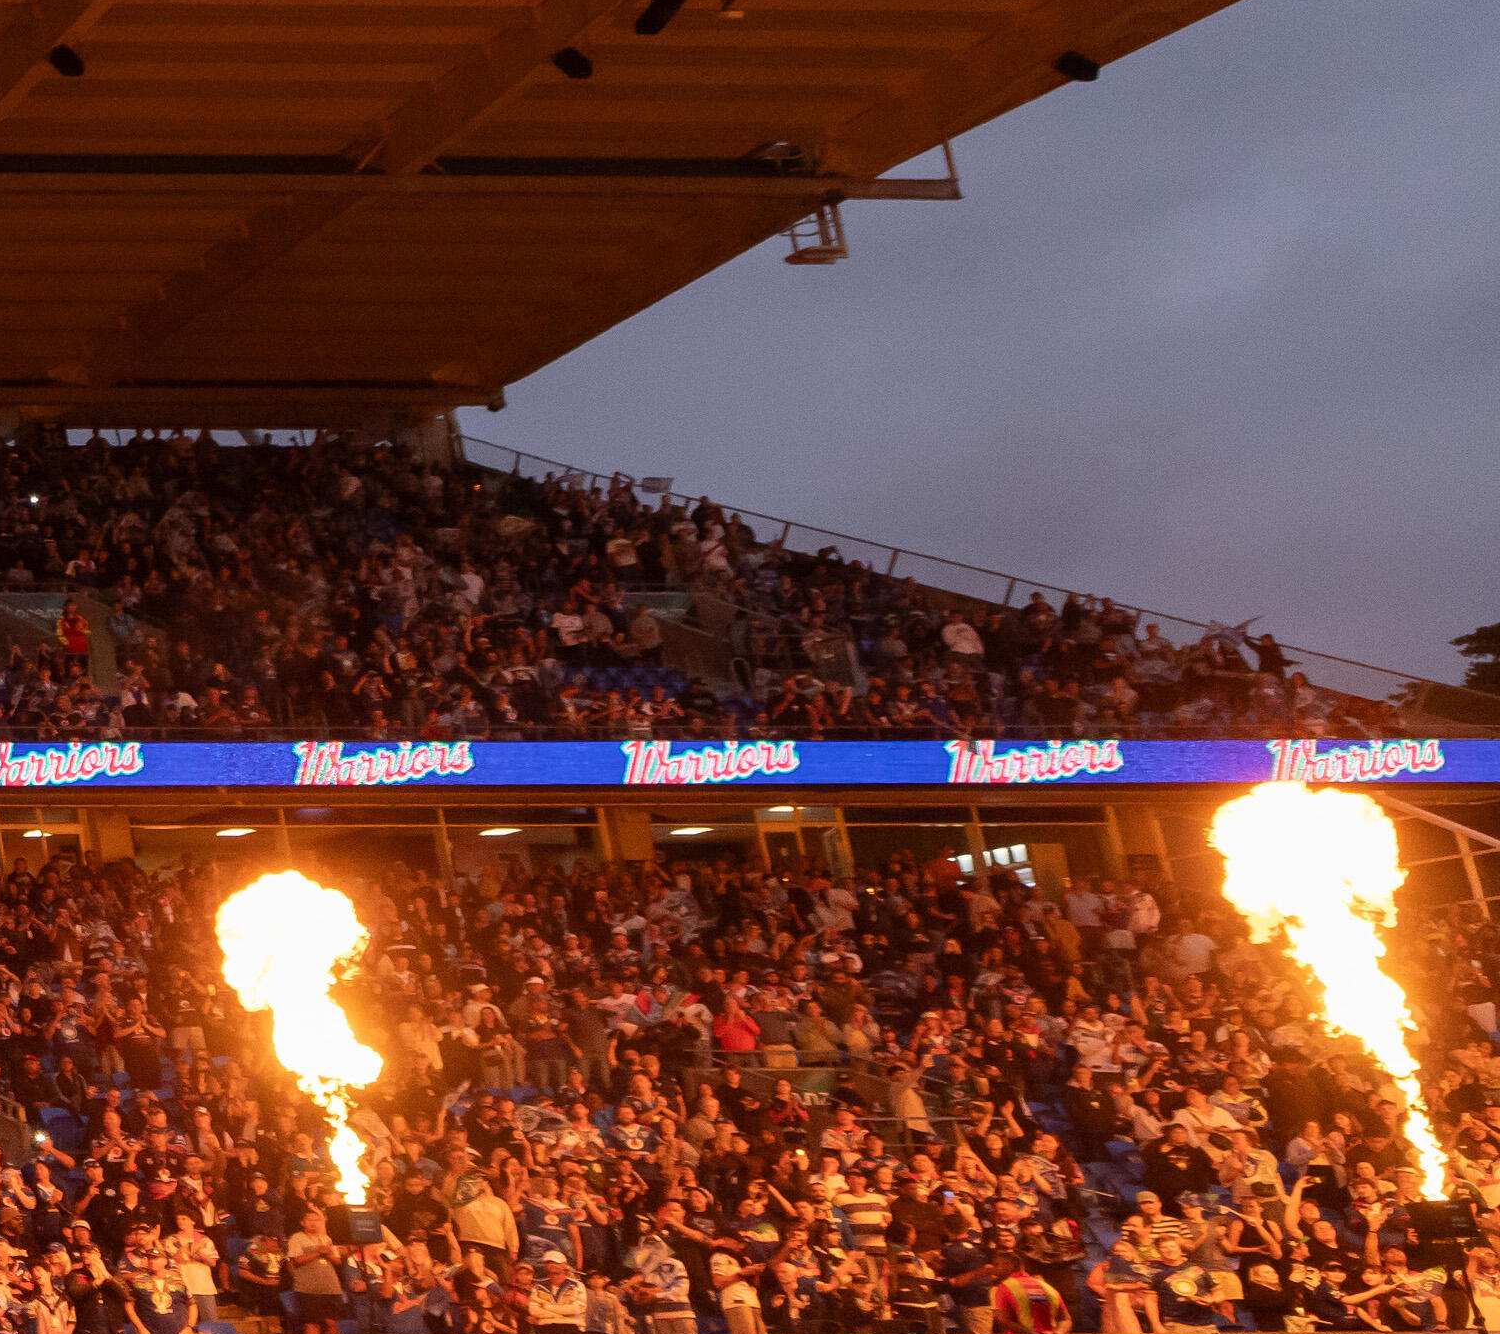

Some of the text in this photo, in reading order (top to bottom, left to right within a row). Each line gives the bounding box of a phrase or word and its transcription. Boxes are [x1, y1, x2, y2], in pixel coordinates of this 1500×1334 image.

[293, 741, 474, 785] Warriors
[620, 741, 800, 785] Warriors
[946, 739, 1123, 783] Warriors
[1267, 739, 1444, 783] Warriors
